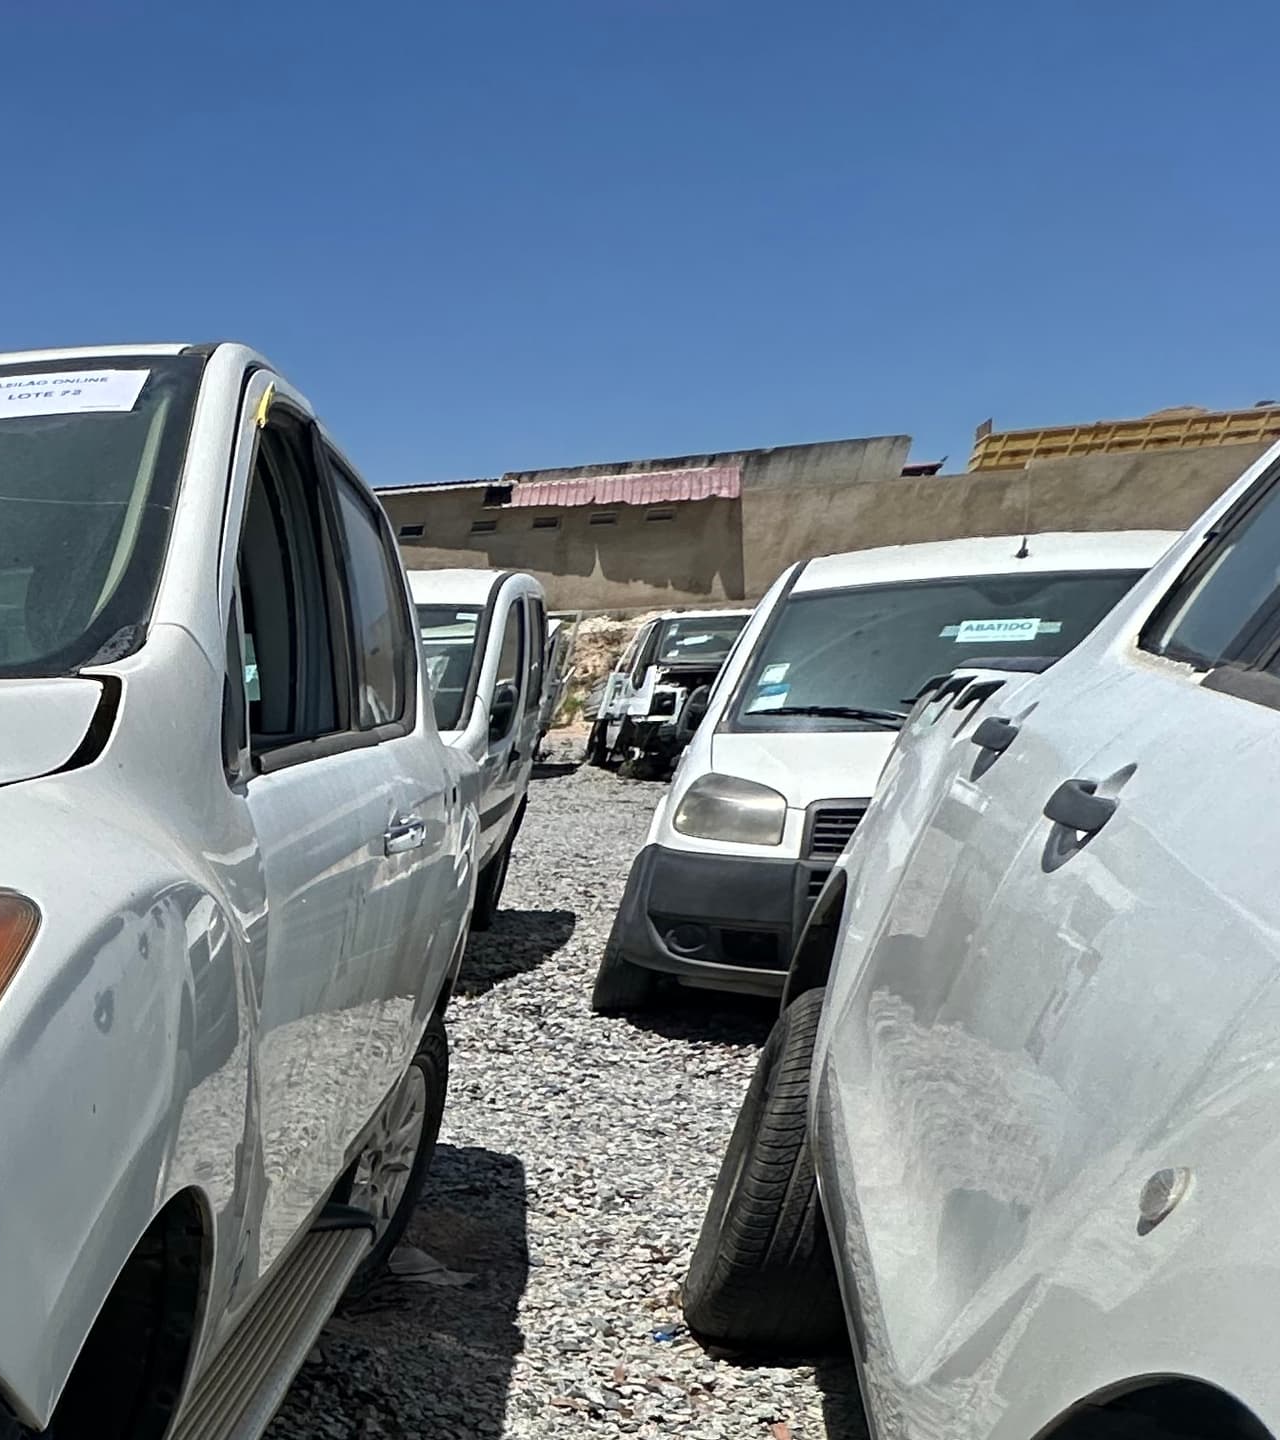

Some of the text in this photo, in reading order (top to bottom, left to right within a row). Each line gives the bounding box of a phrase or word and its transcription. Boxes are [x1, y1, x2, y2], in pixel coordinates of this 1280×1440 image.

[53, 377, 108, 385] ONLINE
[8, 391, 53, 400] LOTE
[964, 623, 1032, 631] ABATIDO
